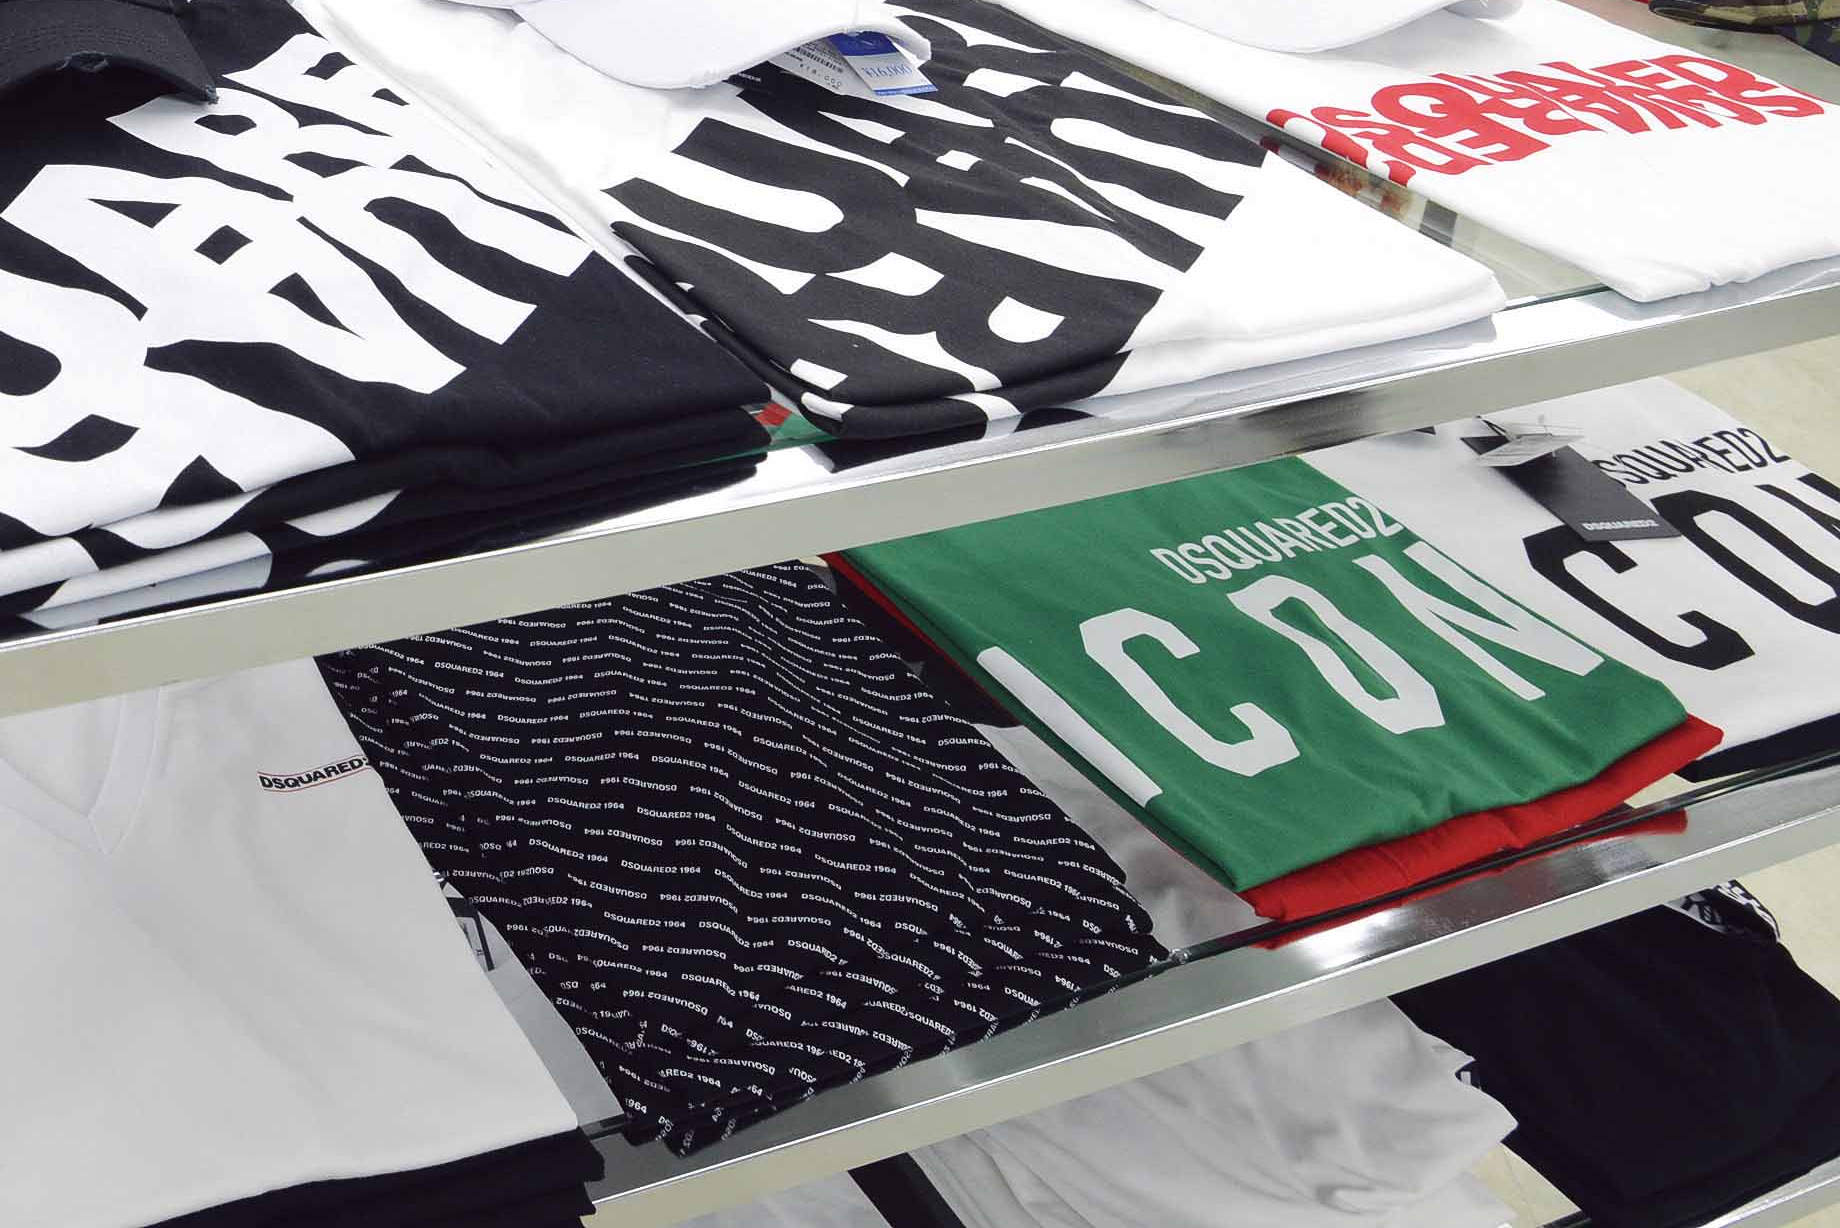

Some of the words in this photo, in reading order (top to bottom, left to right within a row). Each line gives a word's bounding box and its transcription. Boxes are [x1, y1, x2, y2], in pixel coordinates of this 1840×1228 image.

[1591, 427, 1792, 485] SQUARED2
[1581, 518, 1661, 532] DSQUARED2
[1149, 495, 1404, 586] DSQUARED2
[975, 539, 1606, 808] ICON
[717, 702, 739, 712] 1964
[497, 714, 548, 725] DSQUARED2
[665, 716, 721, 729] DSQUARED2
[722, 724, 742, 737] 1964
[740, 708, 793, 730] DSQUARED2
[448, 723, 467, 736] 1964
[636, 730, 692, 744] DSQUARED2
[468, 732, 520, 745] DSQUARED2
[531, 737, 551, 745] 1964
[552, 731, 603, 744] DSQUARED2
[703, 742, 725, 753] 1964
[479, 753, 532, 765] DSQUARED2
[533, 756, 553, 764] 1964
[564, 752, 616, 763] DSQUARED2
[618, 751, 640, 761] 1964
[727, 748, 778, 776] DSQUARED2
[651, 755, 707, 771] DSQUARED2
[709, 765, 729, 779] 1964
[535, 775, 589, 785] DSQUARED2
[600, 776, 620, 785] 1964
[622, 776, 678, 792] DSQUARED2
[689, 785, 712, 796] 1964
[738, 780, 792, 805] DSQUARED2
[794, 800, 816, 809] 1964
[547, 796, 602, 810] DSQUARED2
[603, 801, 625, 810] 1964
[713, 791, 763, 821] DSQUARED2
[636, 806, 693, 819] DSQUARED2
[694, 811, 716, 822] 1964
[971, 805, 994, 817] 1964
[995, 812, 1052, 823] DSQUARED2
[775, 817, 796, 830] 1964
[923, 805, 977, 832] DSQUARED2
[978, 827, 1001, 838] 1964
[584, 828, 605, 836] 1964
[606, 828, 663, 847] DSQUARED2
[726, 823, 778, 850] DSQUARED2
[779, 844, 802, 855] 1964
[798, 826, 856, 842] DSQUARED2
[675, 838, 697, 847] 1964
[1013, 836, 1072, 846] DSQUARED2
[1073, 839, 1096, 851] 1964
[528, 838, 585, 860] DSQUARED2
[586, 853, 609, 863] 1964
[698, 839, 748, 869] DSQUARED2
[620, 859, 678, 874] DSQUARED2
[679, 866, 701, 874] 1964
[759, 867, 782, 876] 1964
[814, 853, 872, 872] DSQUARED2
[873, 865, 897, 875] 1964
[567, 872, 588, 887] 1964
[714, 868, 764, 900] DSQUARED2
[765, 891, 788, 899] 1964
[784, 870, 842, 891] DSQUARED2
[589, 881, 648, 900] DSQUARED2
[659, 893, 682, 902] 1964
[854, 891, 877, 901] 1964
[683, 894, 739, 915] DSQUARED2
[878, 893, 939, 913] DSQUARED2
[801, 893, 858, 919] DSQUARED2
[859, 917, 882, 929] 1964
[603, 910, 662, 927] DSQUARED2
[663, 920, 686, 928] 1964
[746, 915, 769, 924] 1964
[771, 915, 832, 926] DSQUARED2
[698, 921, 751, 949] DSQUARED2
[752, 939, 775, 949] 1964
[641, 944, 665, 953] 1964
[666, 946, 727, 960] DSQUARED2
[622, 989, 645, 998] 1964
[681, 973, 736, 997] DSQUARED2
[738, 989, 760, 1002] 1964
[647, 991, 709, 1016] DSQUARED2
